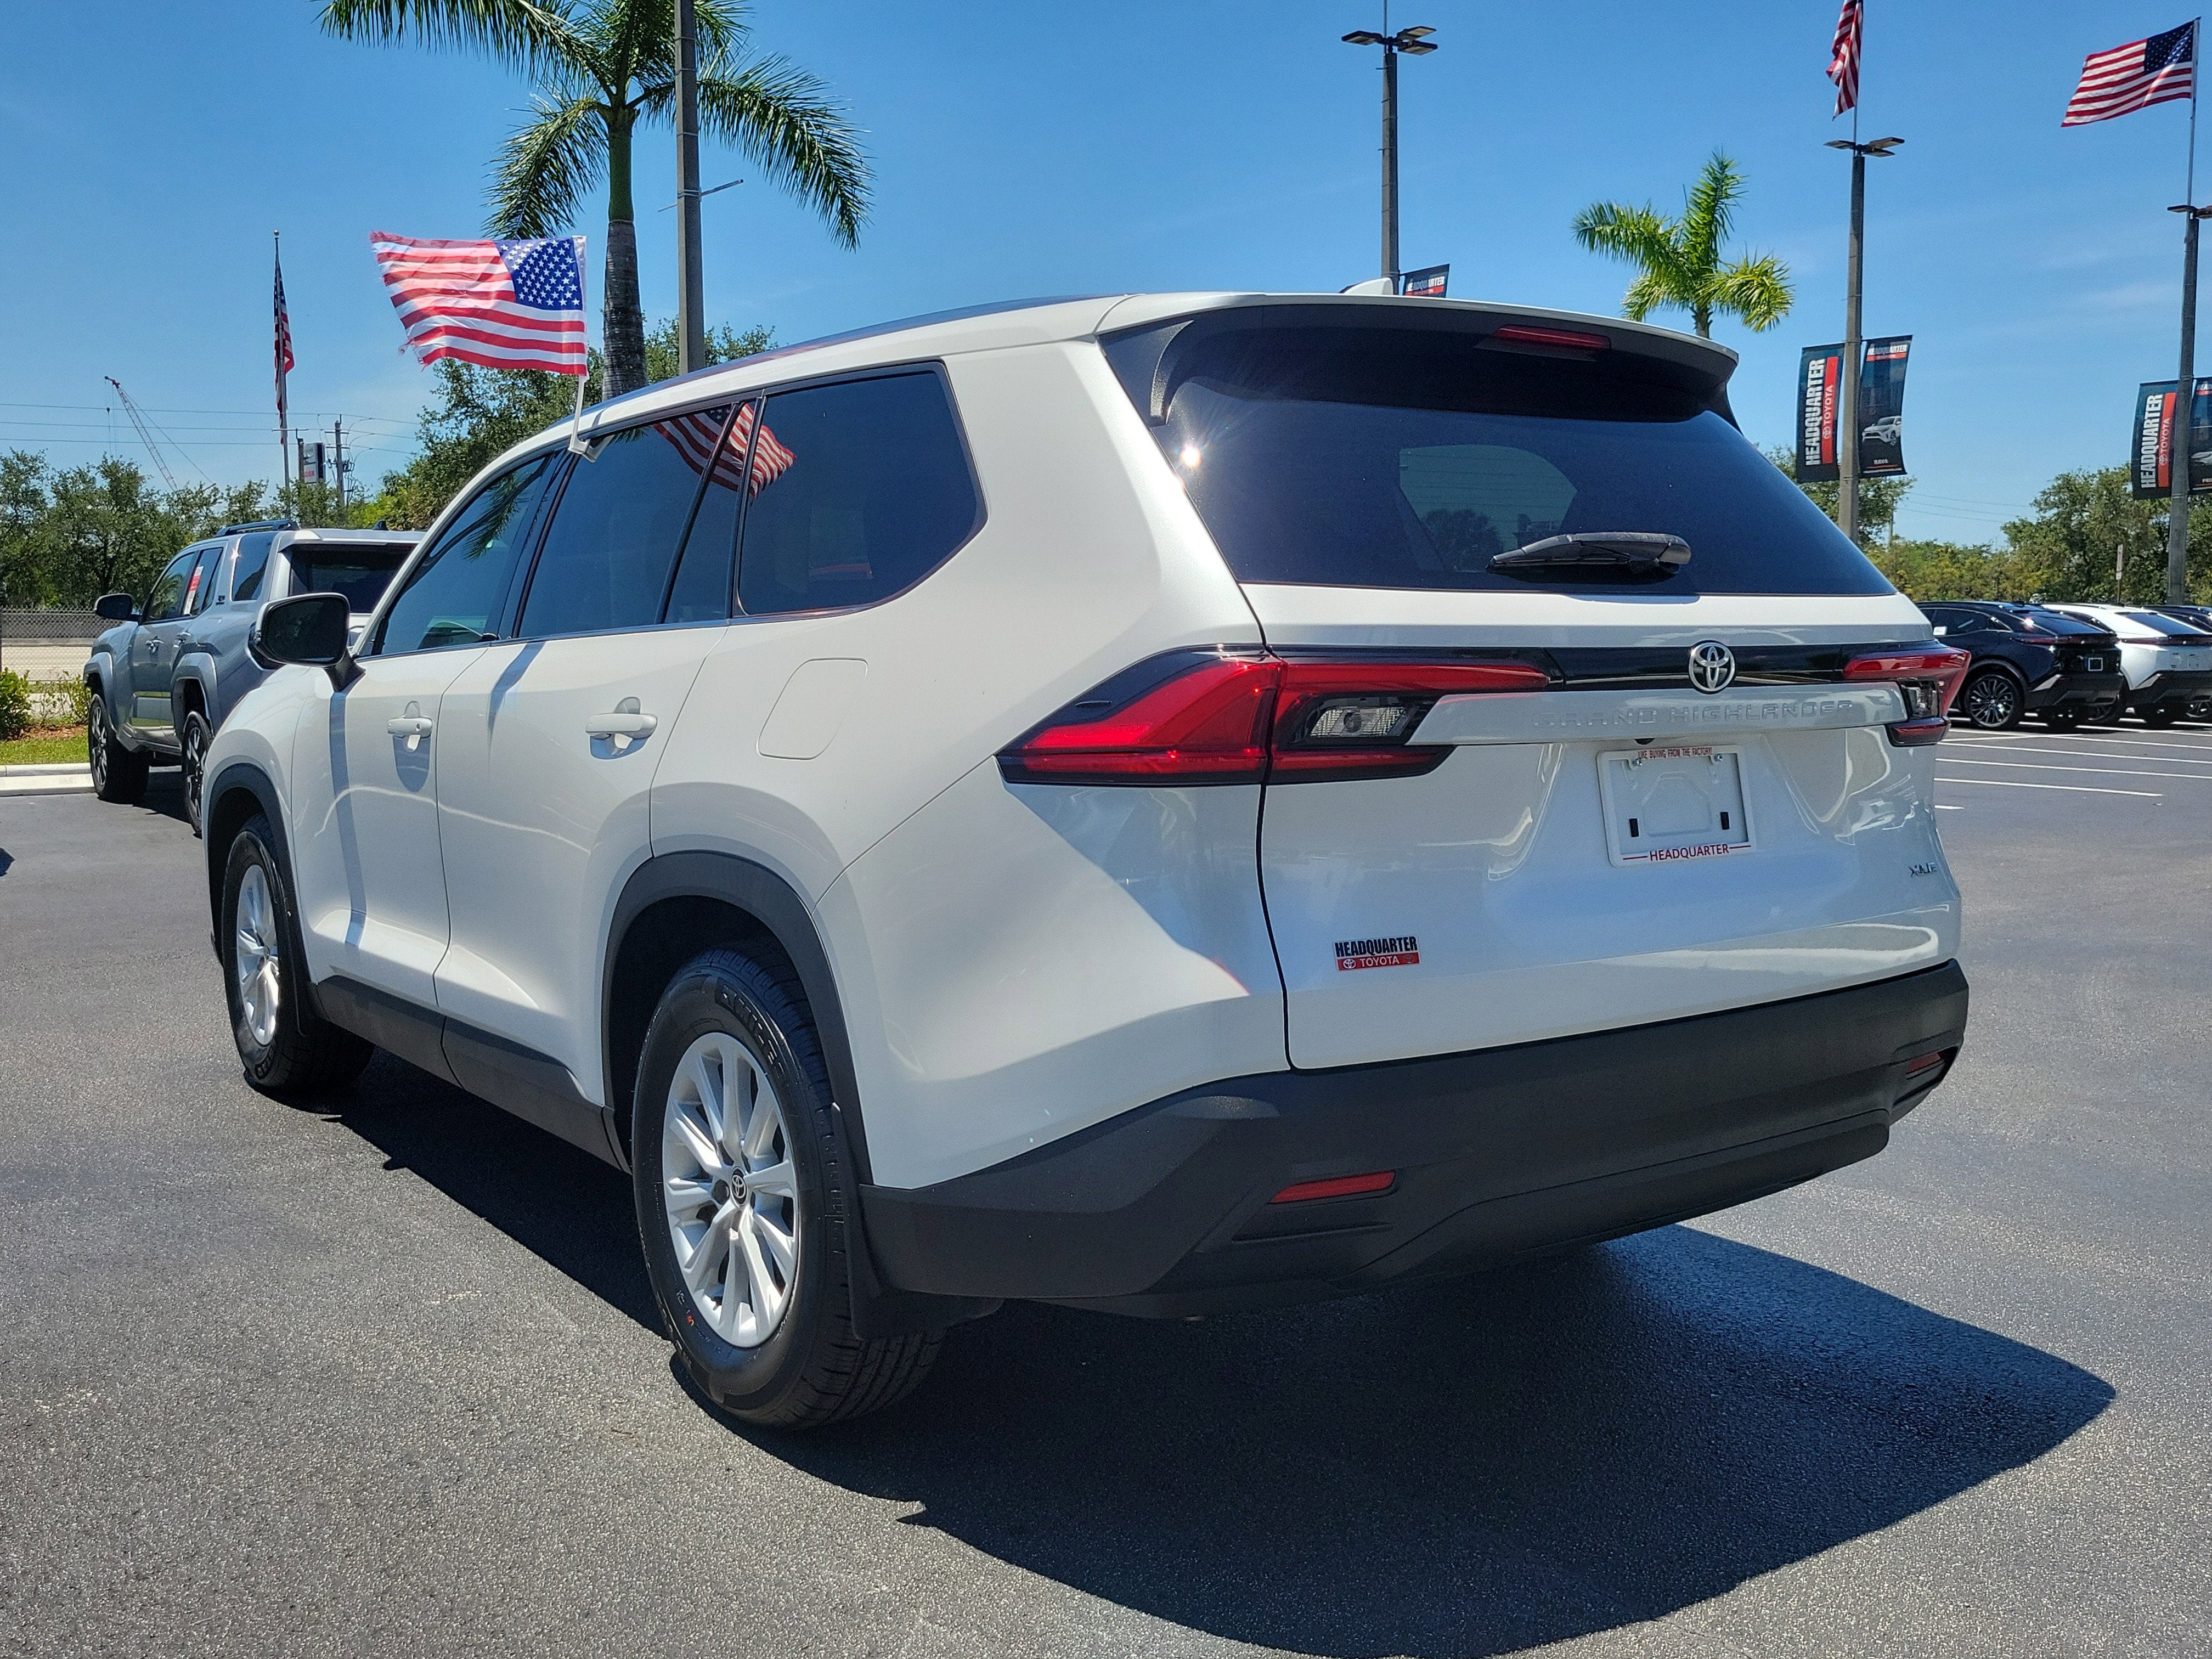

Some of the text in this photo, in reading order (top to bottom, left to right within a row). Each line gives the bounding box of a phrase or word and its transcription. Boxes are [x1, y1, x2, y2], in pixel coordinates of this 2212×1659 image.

[1805, 358, 1826, 466] HEADQUARTER
[1824, 385, 1835, 424] TOYOTA
[2141, 393, 2163, 488] HEADQUARTER
[2161, 418, 2170, 453] TOYOTA
[1671, 699, 1853, 723] HIGHLANDER
[1649, 749, 1667, 759] BUYING
[1668, 748, 1680, 758] FROM
[1682, 748, 1691, 757] THE
[1650, 843, 1729, 861] HEADQUARTER
[1908, 861, 1937, 877] XLE
[1334, 935, 1418, 957] HEADQUARTER
[1359, 955, 1400, 967] TOYOTA
